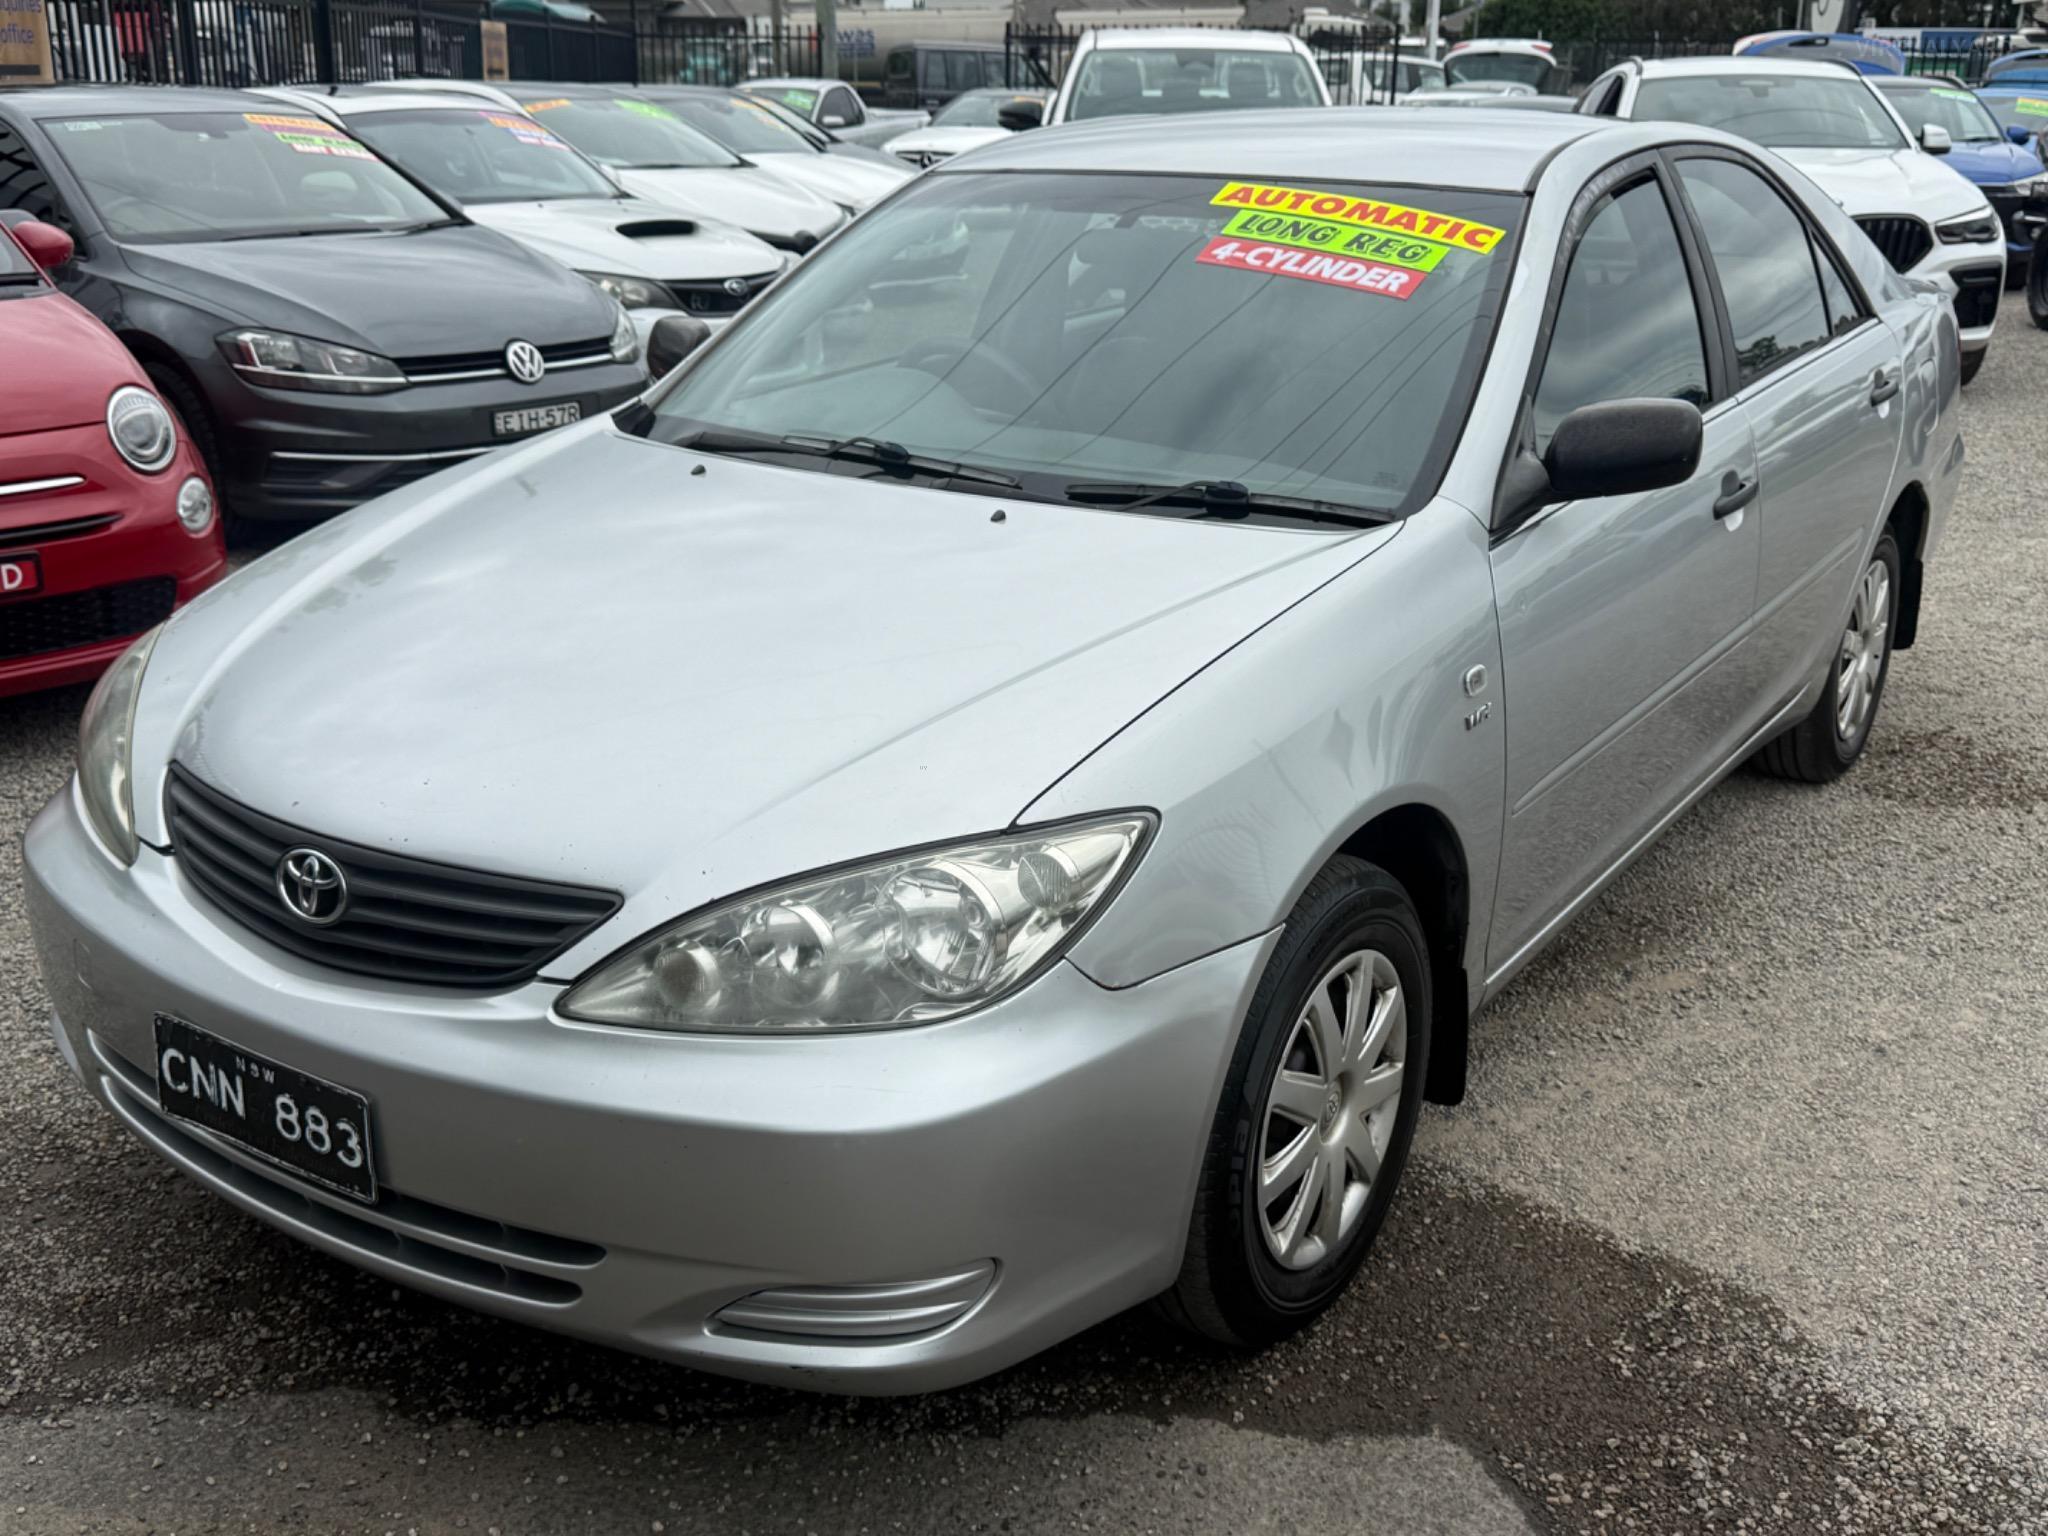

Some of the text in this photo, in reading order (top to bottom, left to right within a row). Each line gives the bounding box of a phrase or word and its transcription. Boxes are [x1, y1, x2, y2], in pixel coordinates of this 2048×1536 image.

[1220, 186, 1495, 248] AUTOMATIC
[1237, 214, 1432, 264] LONG REG
[1210, 241, 1410, 292] 4-CYLINDER
[161, 1048, 363, 1168] CNN 883
